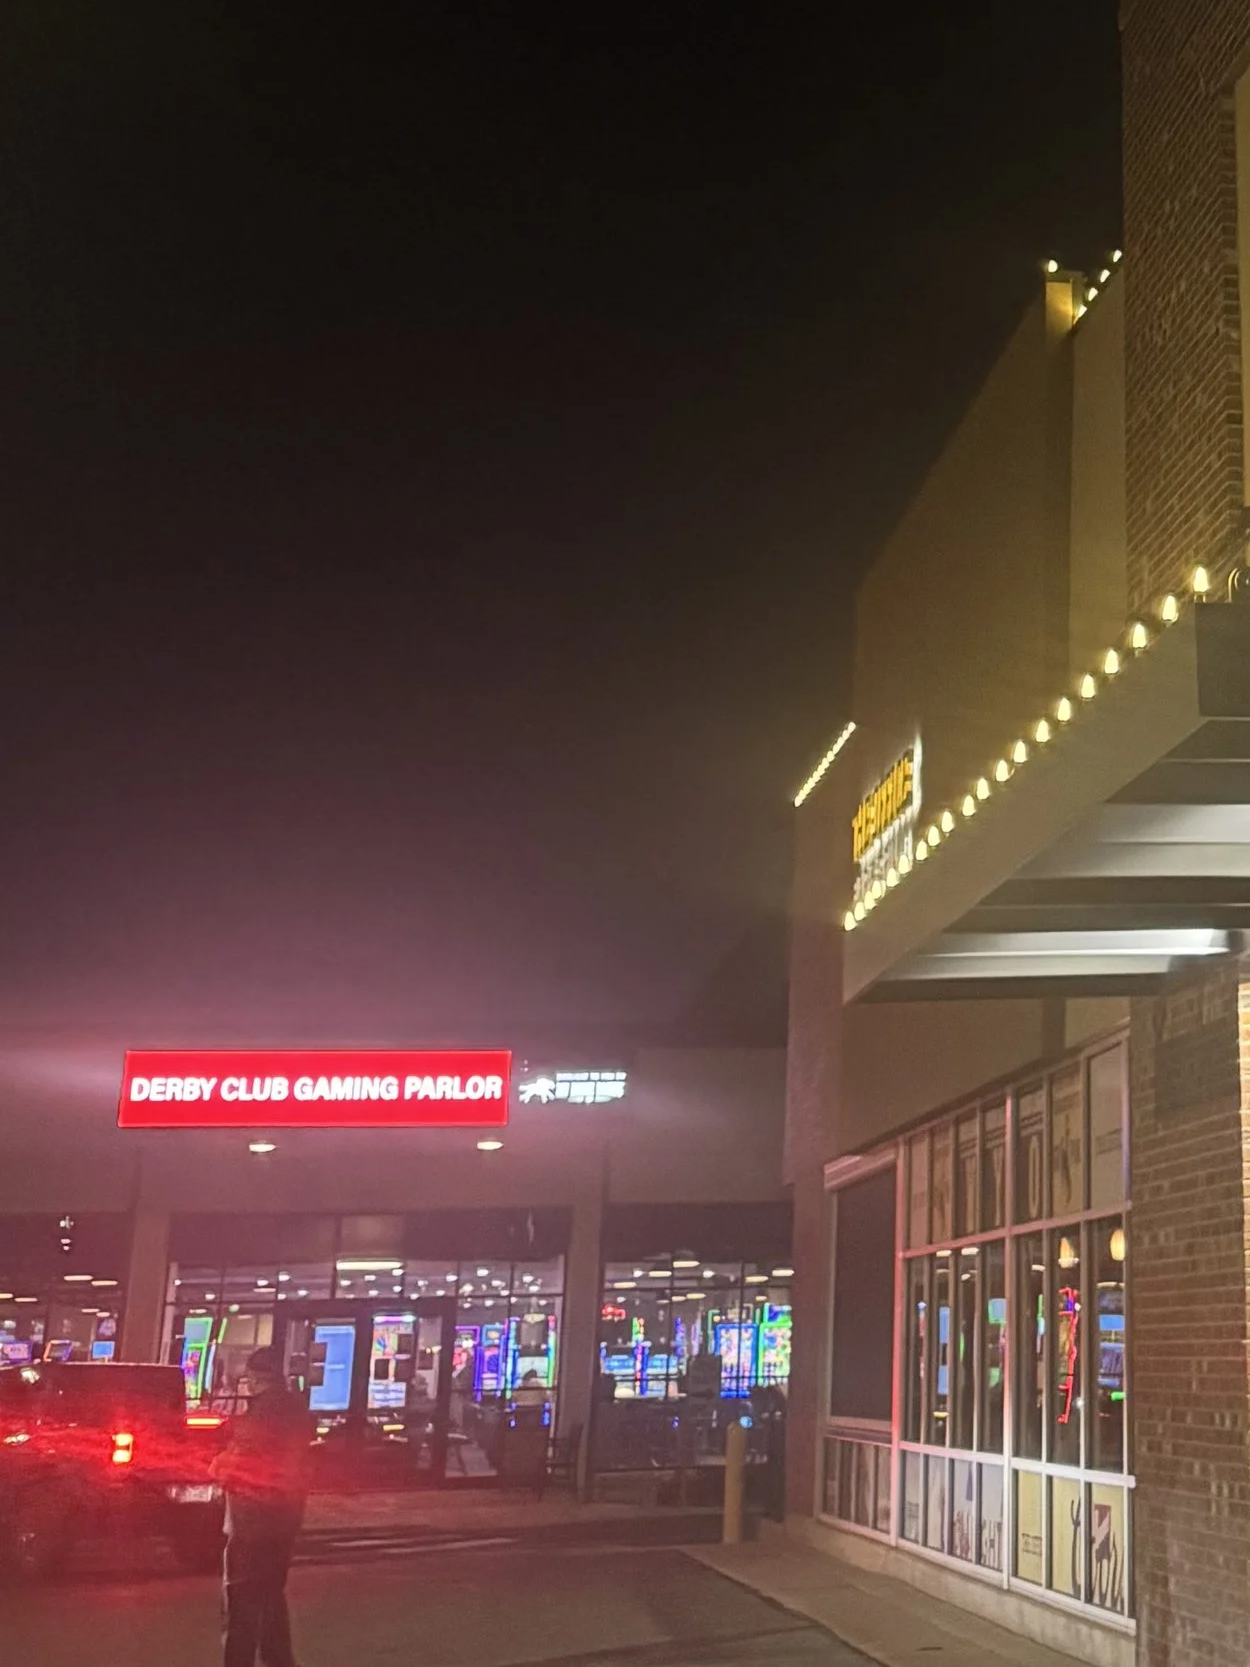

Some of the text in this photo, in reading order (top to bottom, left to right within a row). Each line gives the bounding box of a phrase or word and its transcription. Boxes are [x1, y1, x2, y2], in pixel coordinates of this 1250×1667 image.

[129, 1074, 504, 1102] DERBY CLUB GAMING PARLOR
